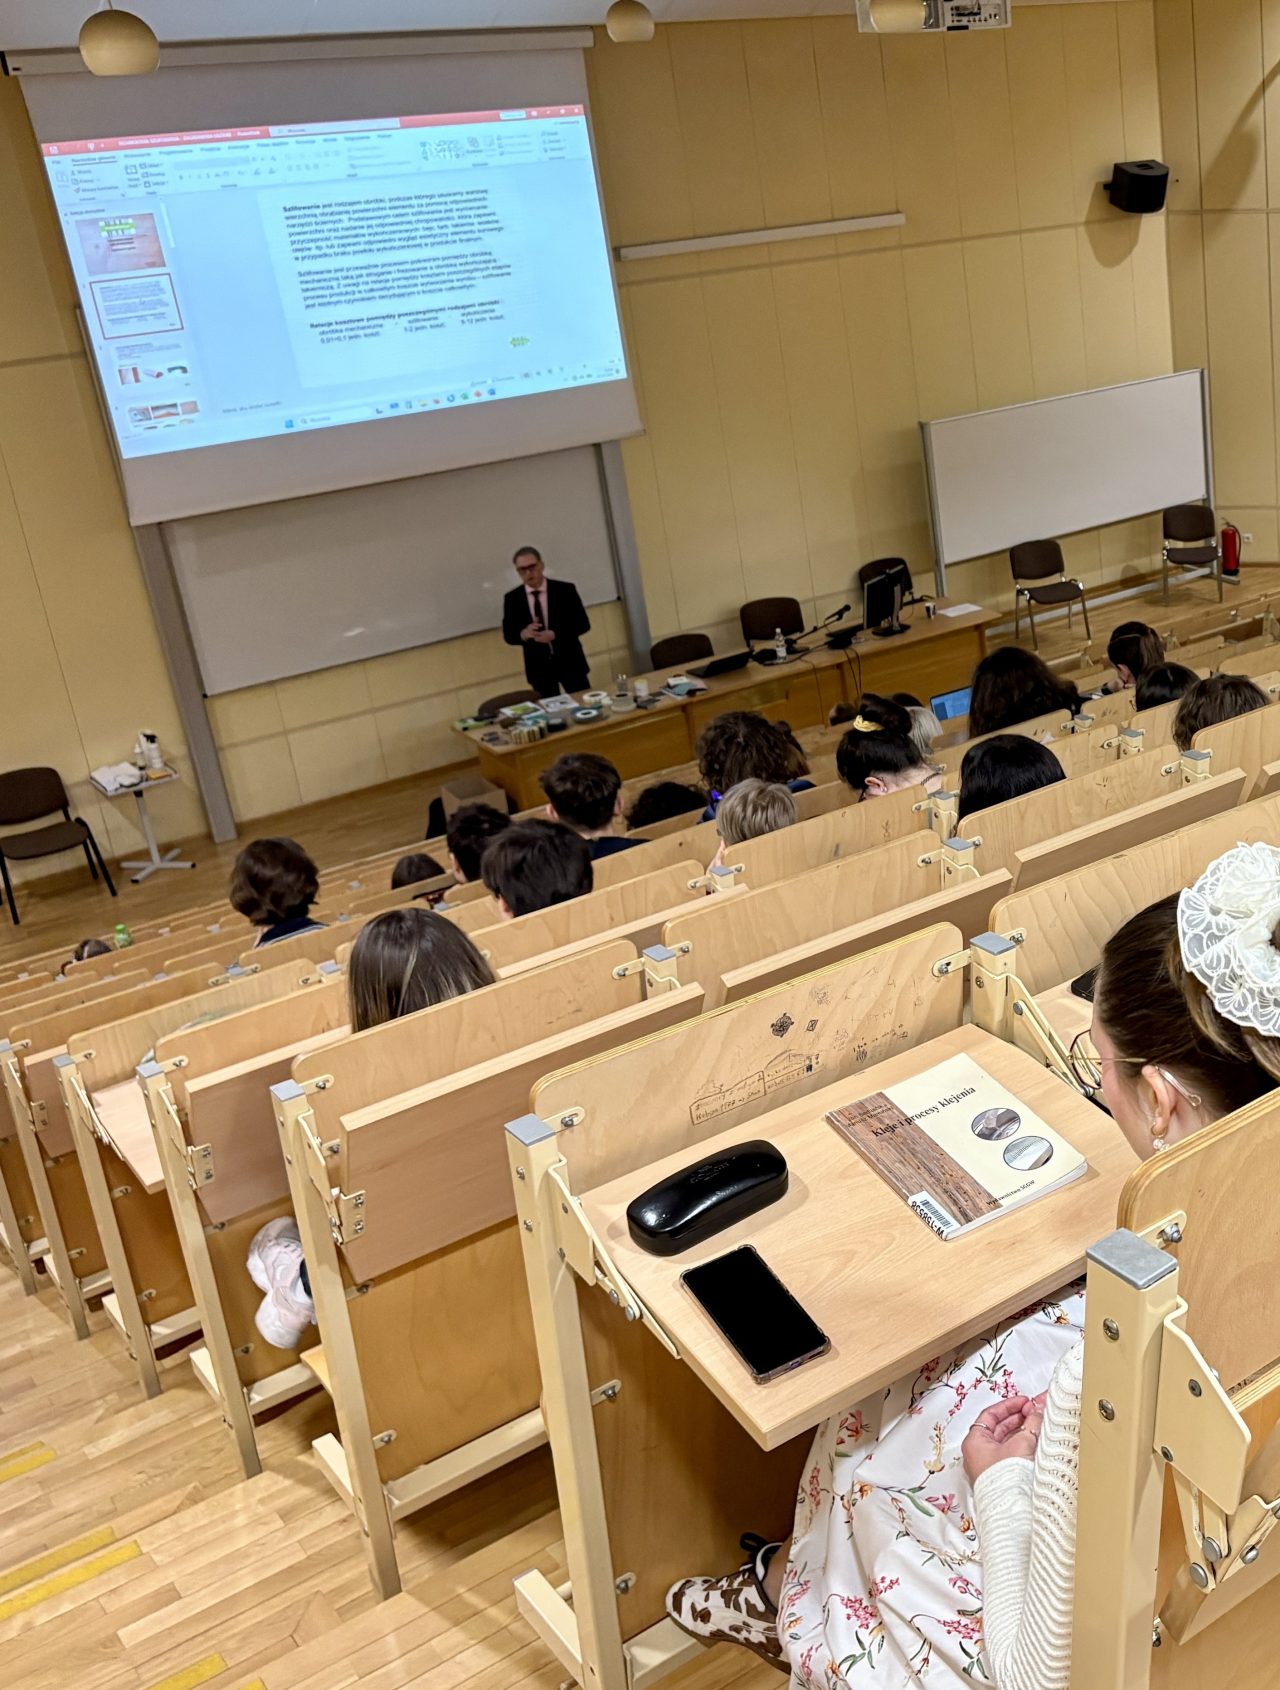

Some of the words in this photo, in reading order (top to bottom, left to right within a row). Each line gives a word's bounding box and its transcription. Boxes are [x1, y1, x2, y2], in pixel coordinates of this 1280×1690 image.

[871, 1119, 901, 1138] Kleje
[898, 1118, 905, 1127] i
[904, 1103, 940, 1126] procesy
[937, 1085, 977, 1108] klejenia
